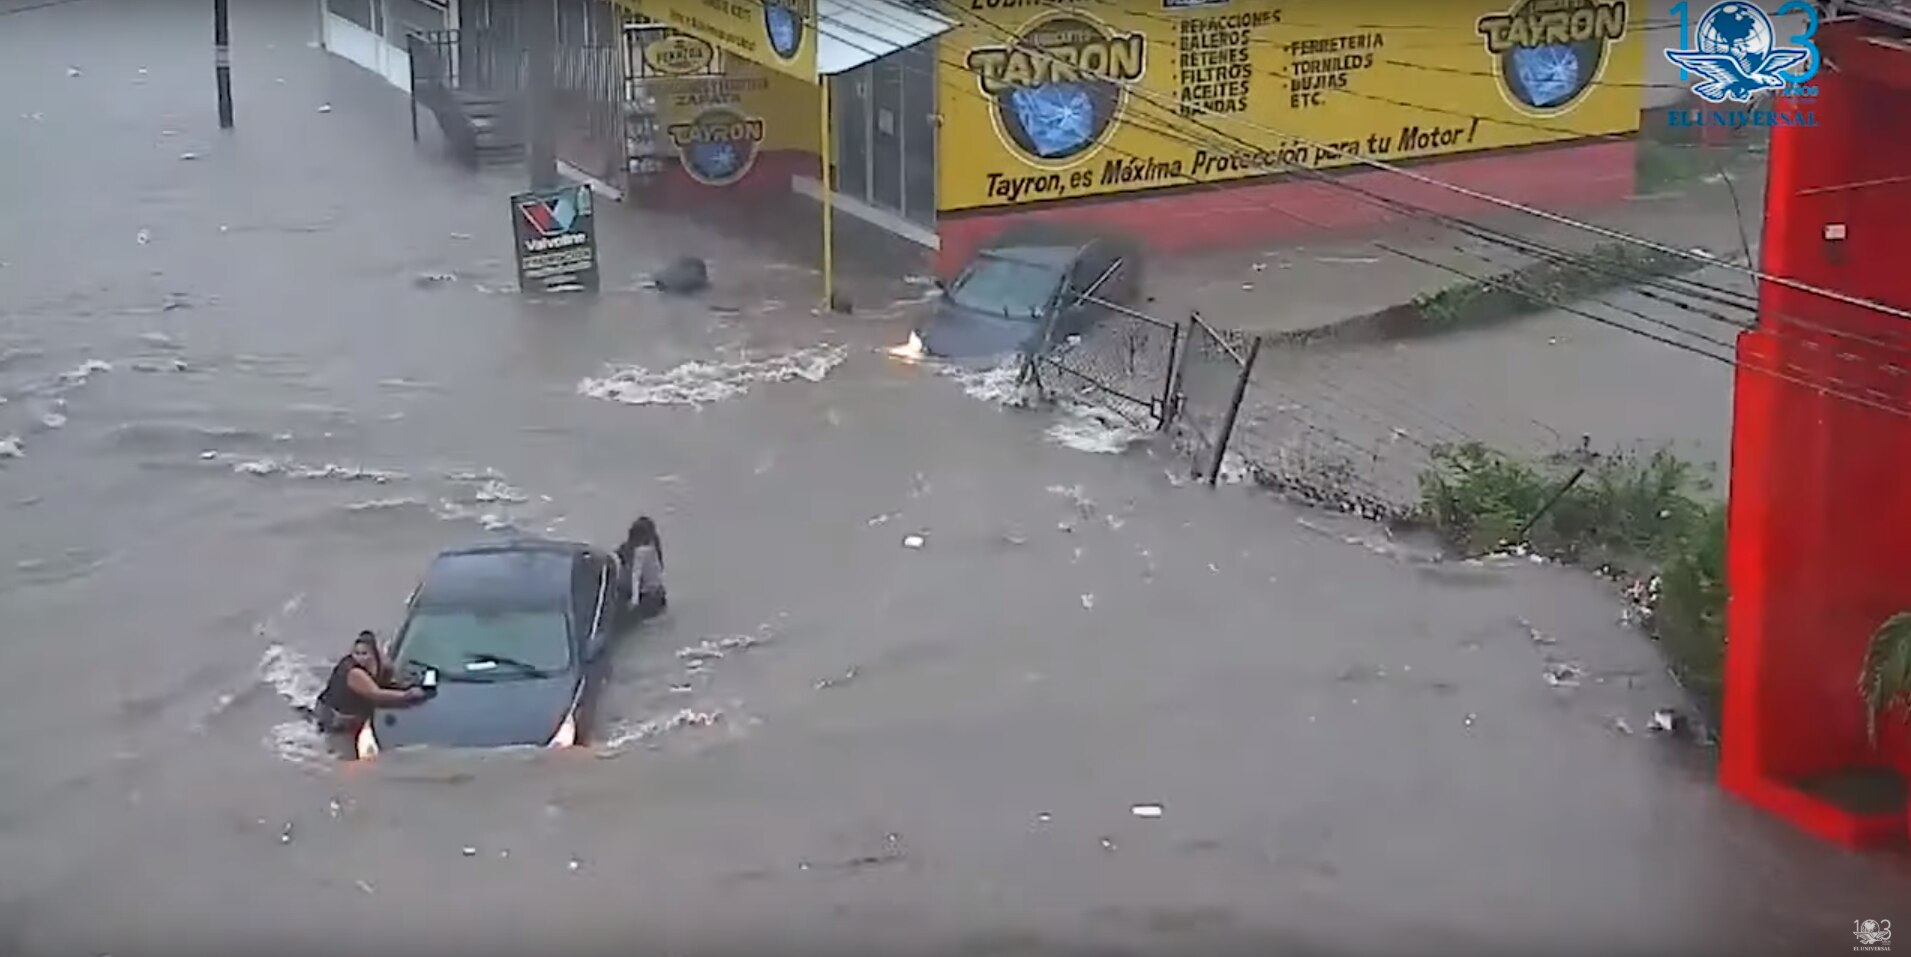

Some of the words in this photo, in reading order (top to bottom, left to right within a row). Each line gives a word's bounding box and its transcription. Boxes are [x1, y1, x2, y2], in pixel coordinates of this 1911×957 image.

[1180, 10, 1281, 33] REFACCIONES
[1478, 1, 1626, 53] TAYRON
[1180, 29, 1251, 51] BALEROS
[1291, 33, 1384, 56] FERRETERIA
[966, 34, 1144, 96] TAYRON
[1180, 47, 1249, 67] RETENES
[1291, 53, 1374, 76] TORNILLOS
[1180, 63, 1252, 84] FILTROS
[1290, 73, 1348, 92] BUJIAS
[1181, 80, 1250, 101] ACEITES
[1290, 91, 1326, 109] ETC.
[668, 119, 763, 147] TAYRON
[987, 171, 1066, 201] Tayron,
[1070, 169, 1093, 189] es
[1101, 156, 1182, 186] Máxima
[1315, 139, 1361, 167] para
[1366, 133, 1392, 155] tu
[1398, 124, 1465, 152] Motor
